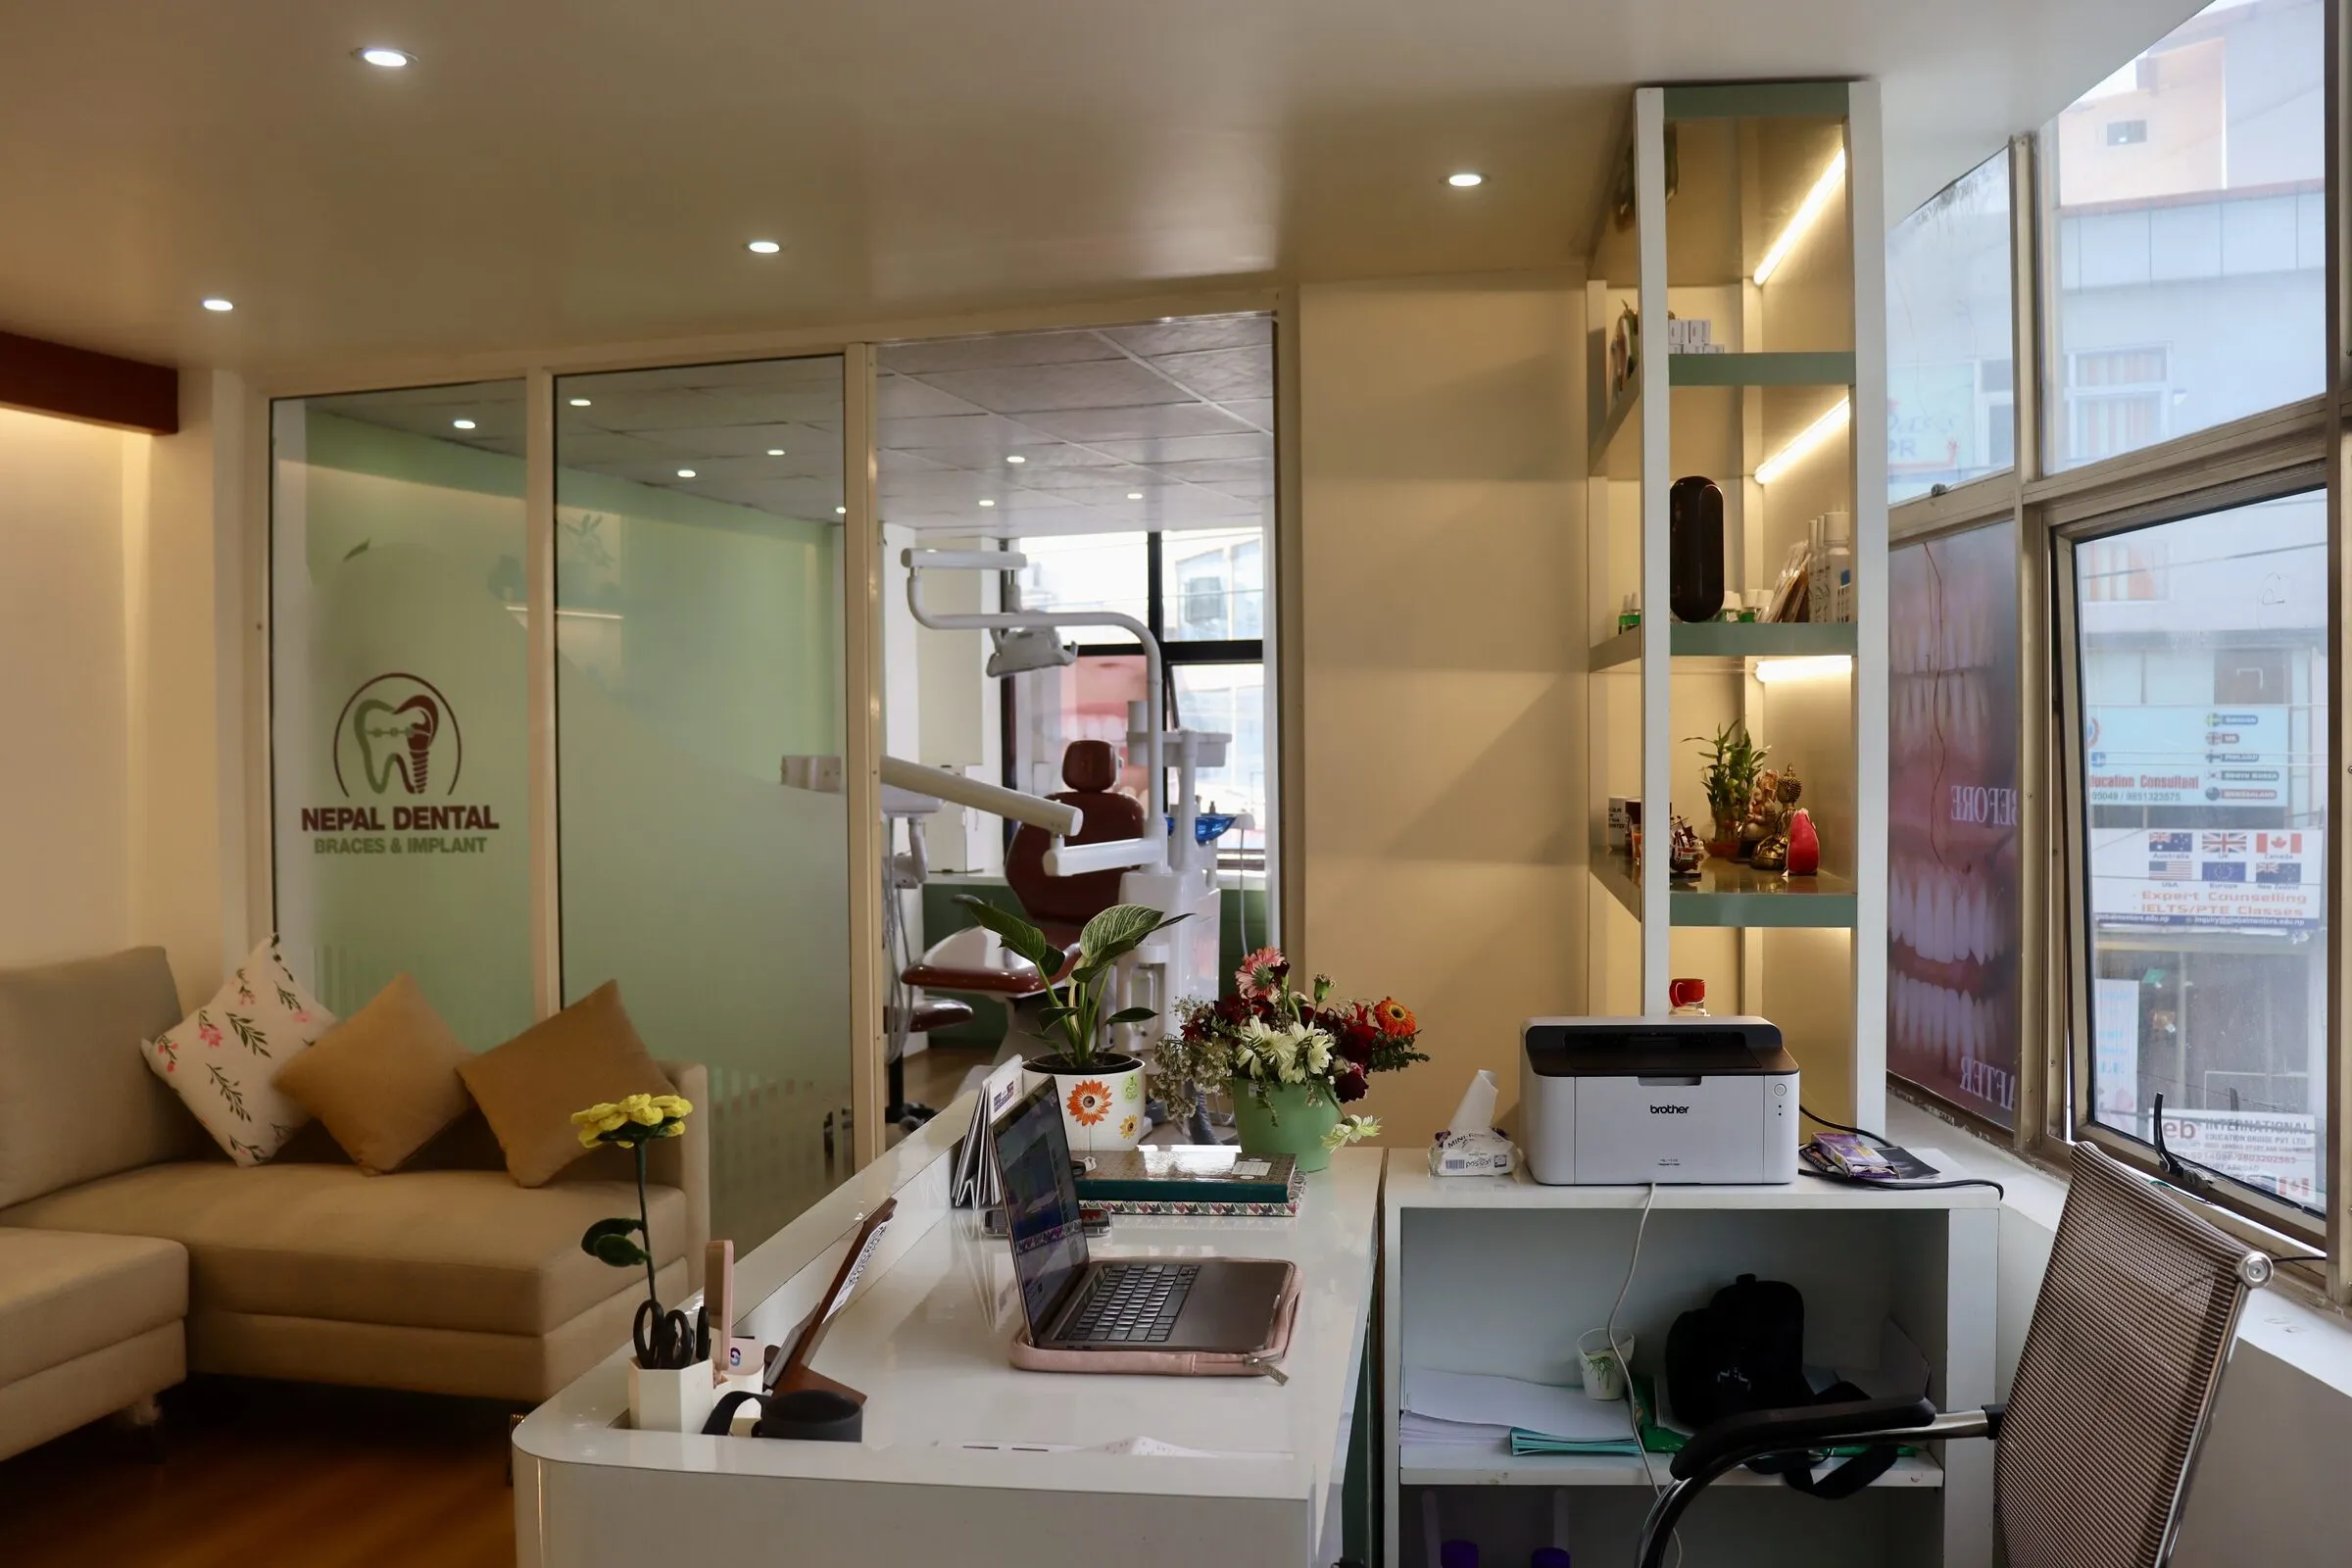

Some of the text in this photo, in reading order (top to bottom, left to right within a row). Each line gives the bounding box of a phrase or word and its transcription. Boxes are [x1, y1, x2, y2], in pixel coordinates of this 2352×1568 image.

[2140, 774, 2199, 789] Consultant
[301, 805, 500, 832] NEPAL DENTAL
[314, 837, 488, 855] BRACES & IMPLANT
[2141, 891, 2307, 905] Expert Counselling
[2141, 904, 2304, 916] IELTS/PTE Classes
[1649, 1104, 1690, 1114] brother
[2205, 1118, 2310, 1135] INTERNATIONAL
[2205, 1134, 2245, 1143] EDUCATION
